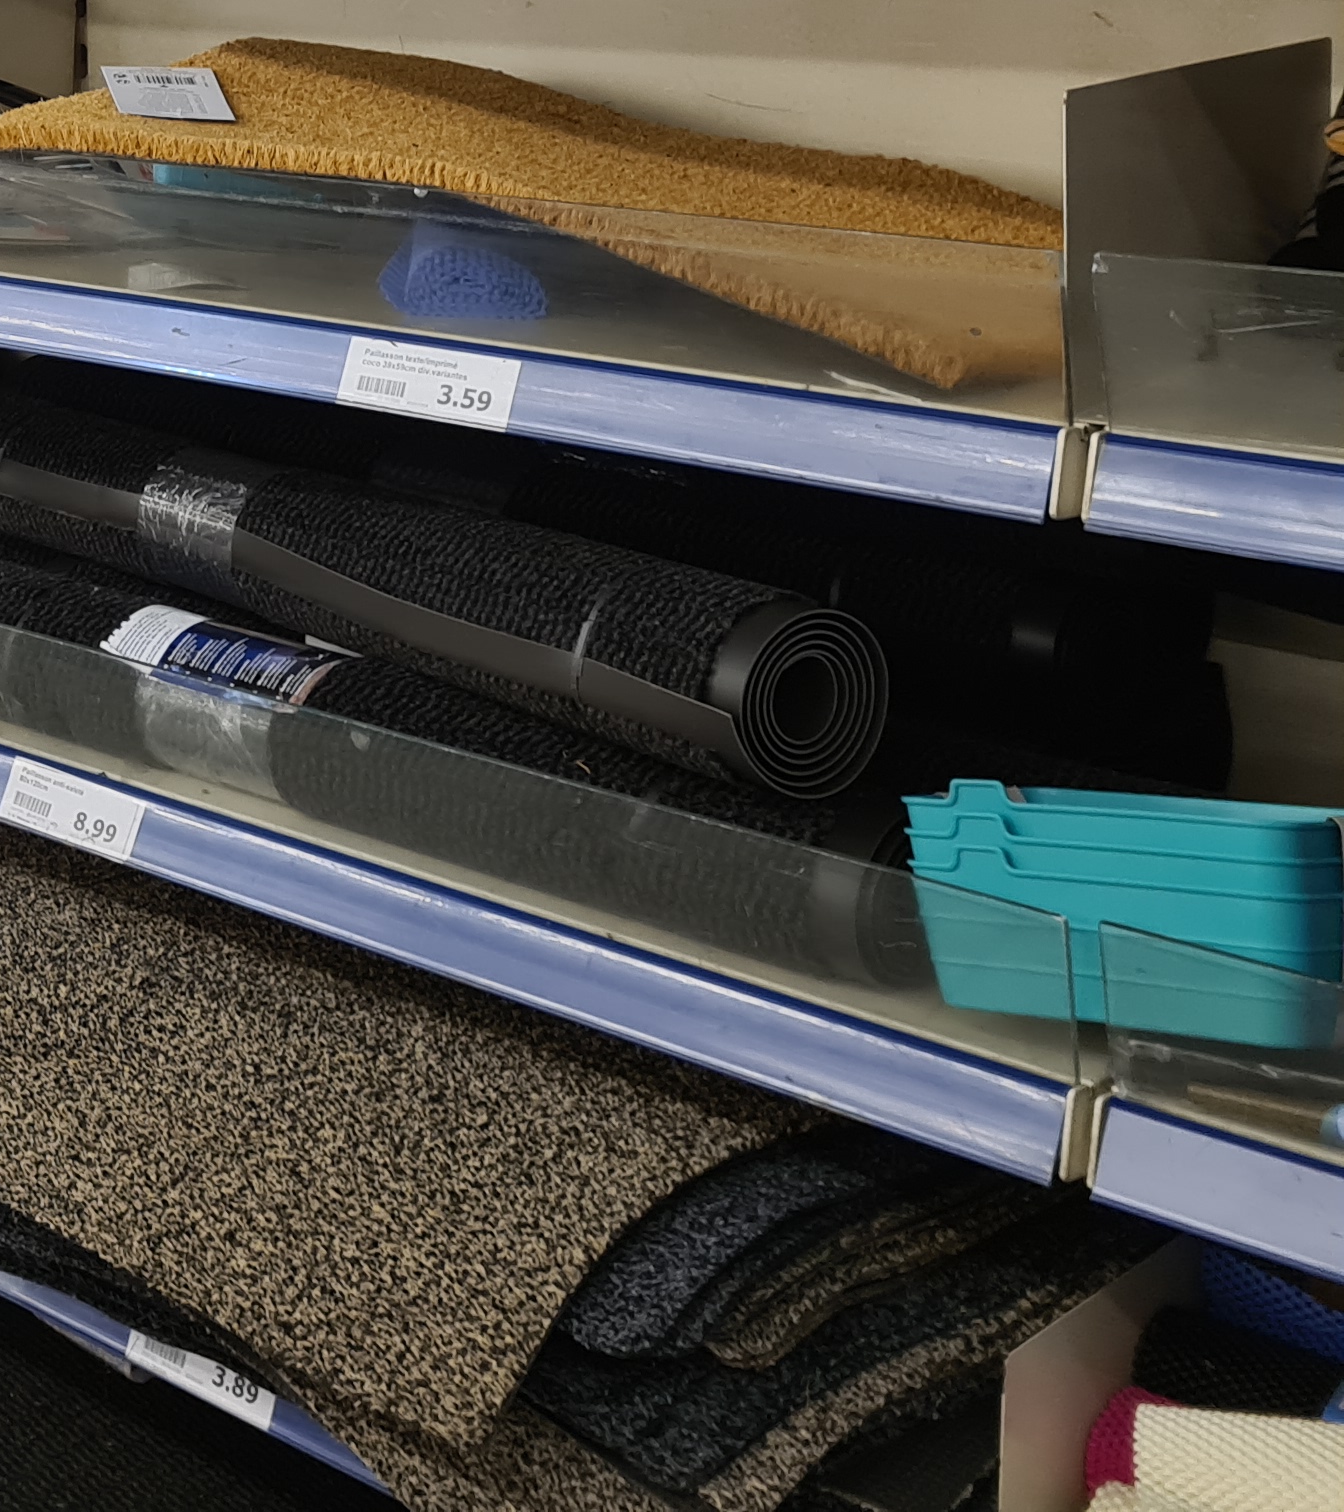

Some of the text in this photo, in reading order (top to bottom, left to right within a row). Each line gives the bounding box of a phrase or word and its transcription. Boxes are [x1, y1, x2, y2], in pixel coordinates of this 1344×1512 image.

[362, 358, 381, 368] coco
[364, 347, 459, 370] Paillasson texte/imprimé
[436, 383, 493, 412] 3.59
[73, 811, 118, 843] 8.99
[211, 1365, 260, 1404] 3.89
